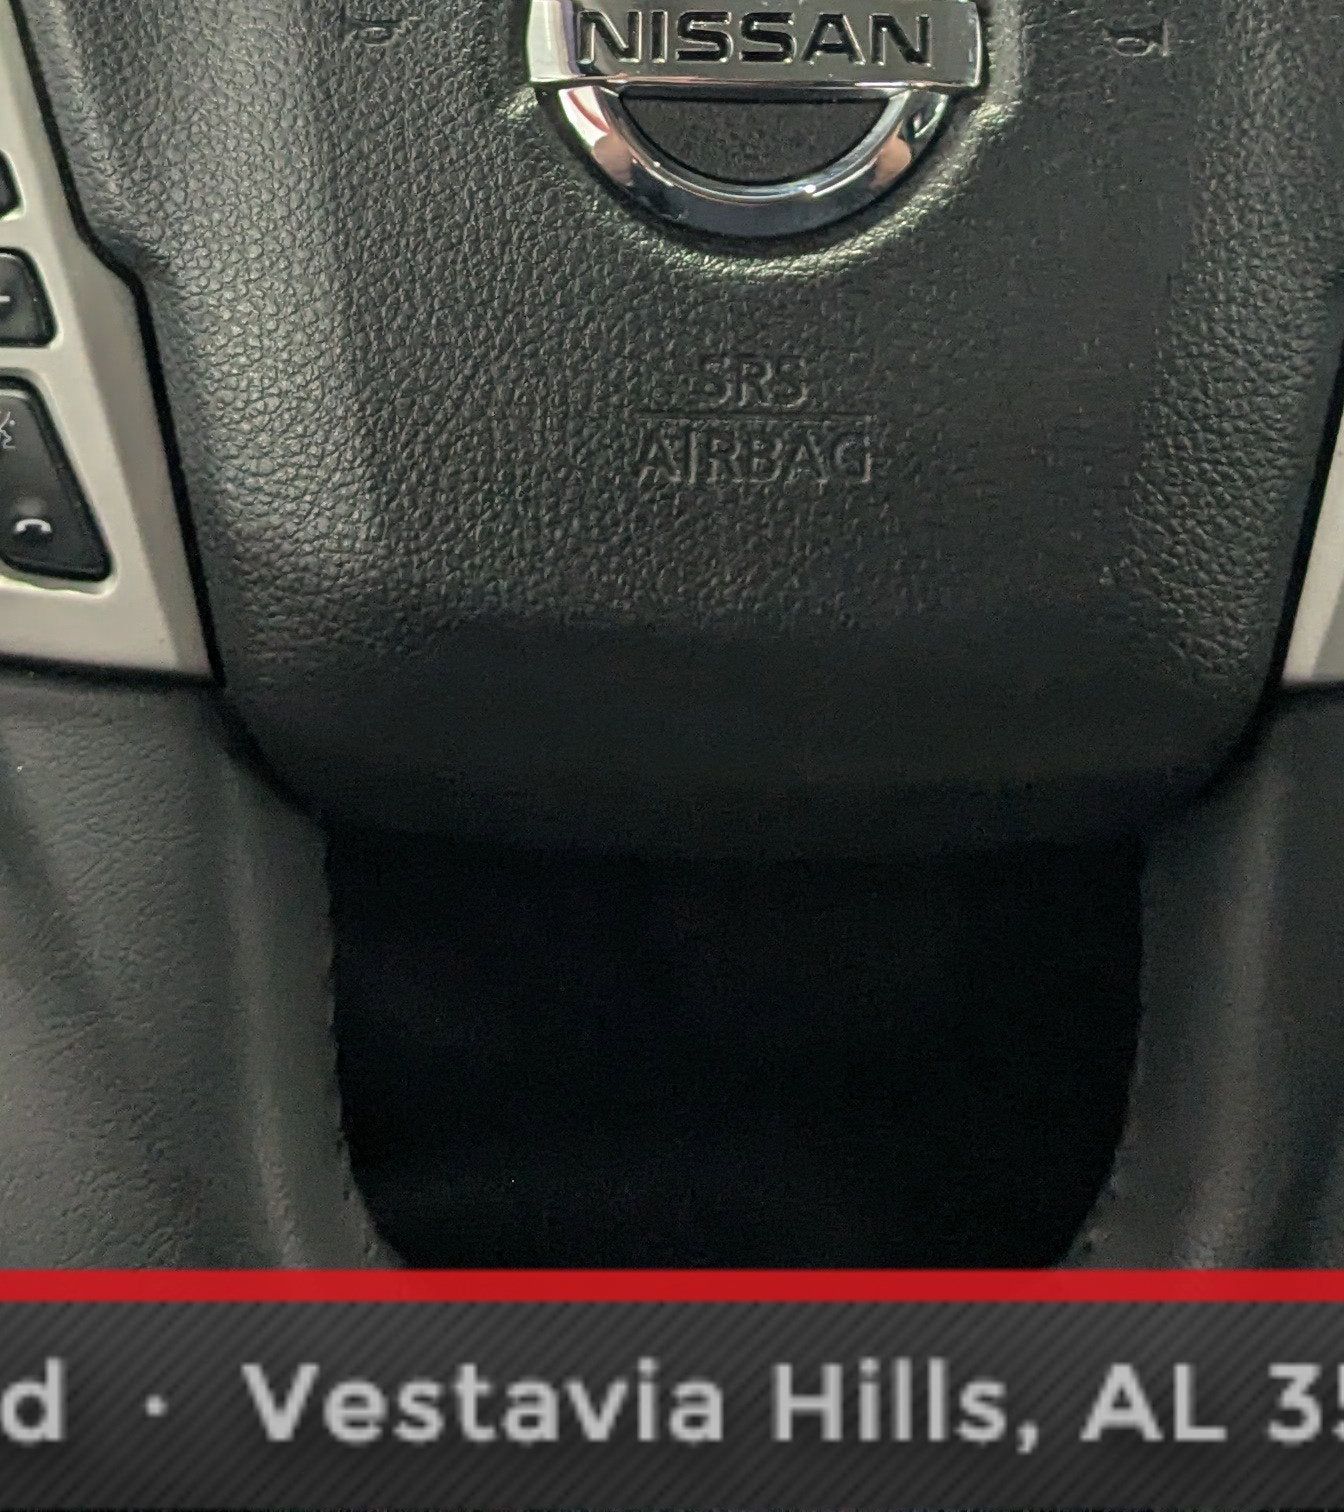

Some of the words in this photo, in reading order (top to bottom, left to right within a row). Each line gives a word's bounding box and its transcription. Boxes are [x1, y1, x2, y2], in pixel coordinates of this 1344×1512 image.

[575, 9, 933, 68] NISSAN
[701, 353, 808, 410] SRS
[636, 429, 873, 486] AIRBAG
